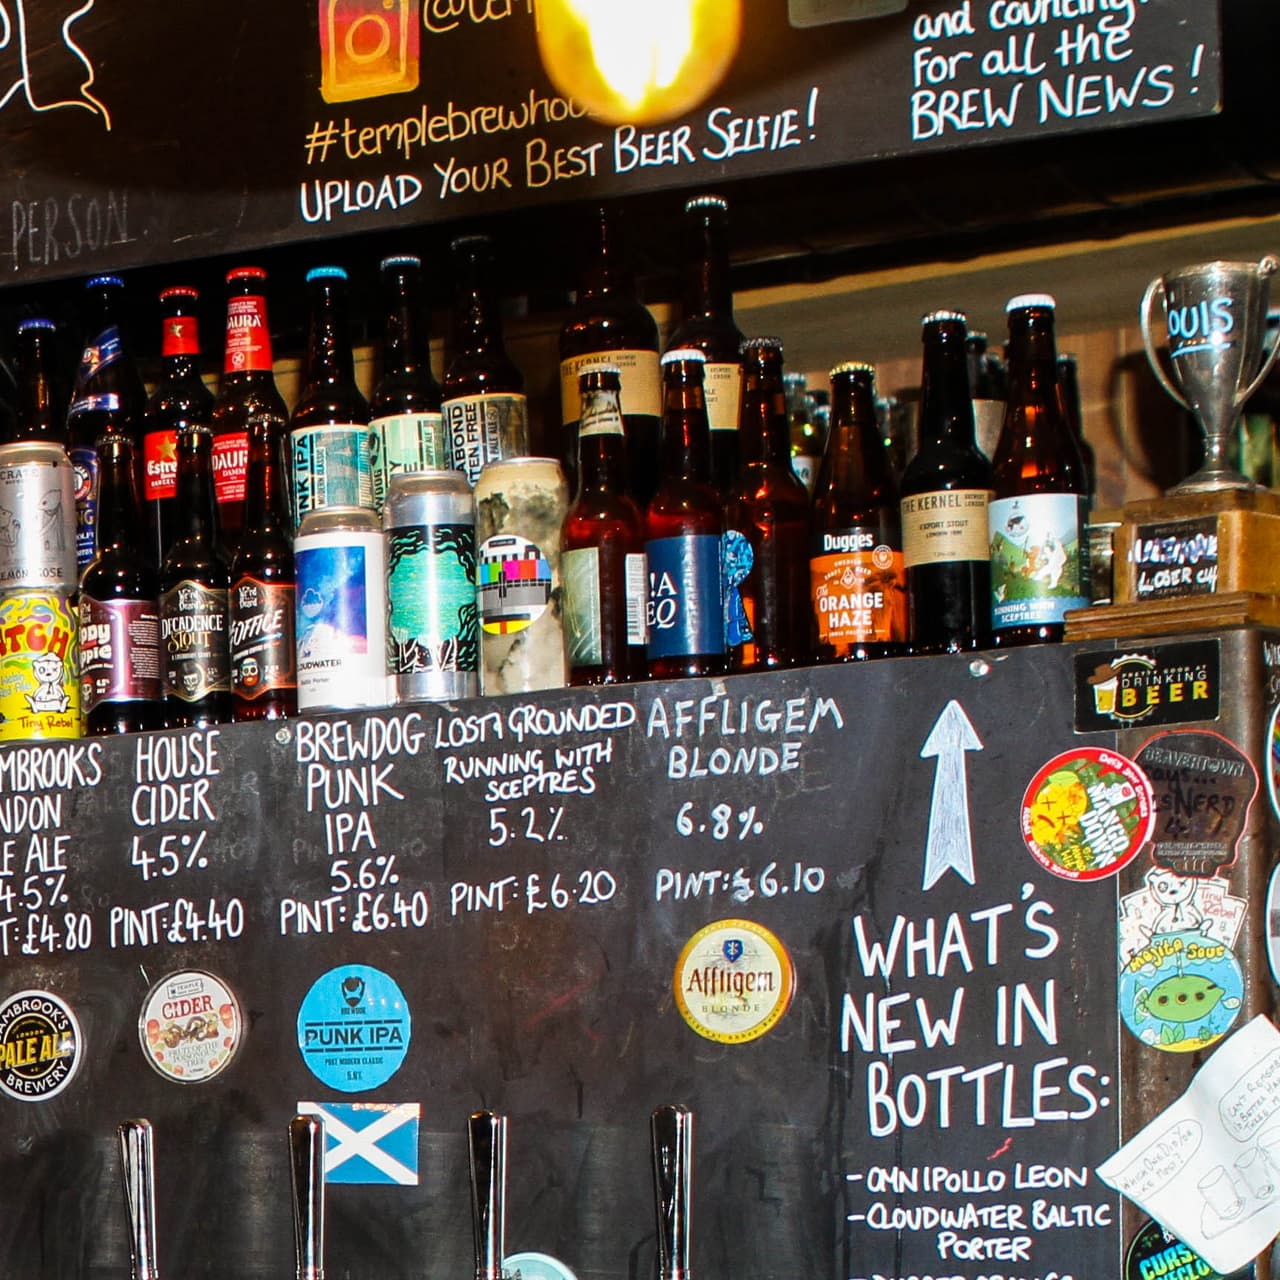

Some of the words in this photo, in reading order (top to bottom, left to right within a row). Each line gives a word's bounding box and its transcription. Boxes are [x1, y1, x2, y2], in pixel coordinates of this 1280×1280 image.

[913, 9, 973, 42] and
[981, 32, 1047, 75] all
[1055, 16, 1134, 66] the
[911, 82, 1024, 140] BREW
[300, 174, 423, 222] UPLOAD
[433, 157, 512, 199] YOUR
[526, 138, 604, 188] BEST
[614, 124, 696, 173] BEER
[918, 495, 961, 512] KERNEL
[823, 530, 873, 552] Dugges
[819, 592, 884, 612] ORANGE
[829, 609, 872, 629] HAZE
[161, 615, 223, 639] DECADENCE
[1122, 670, 1207, 688] DRINKING
[1122, 680, 1209, 707] BEER
[294, 712, 426, 763] BREWDOG
[508, 701, 637, 743] GROUNDED
[646, 696, 844, 740] AFFLIGEM
[136, 729, 221, 784] HOUSE
[444, 750, 542, 785] RUNNING
[554, 742, 612, 767] WITH
[668, 741, 803, 779] BLONDE
[131, 778, 216, 826] CIDER
[307, 763, 405, 812] PUNK
[485, 765, 596, 802] SCEPTRES
[325, 811, 377, 855] IPA
[676, 801, 764, 841] 6.8%
[24, 833, 71, 873] ALE
[853, 882, 1060, 981] WHAT'S
[686, 967, 774, 995] Affligem
[162, 995, 212, 1020] CIDER
[841, 987, 964, 1053] NEW
[997, 979, 1058, 1047] IN
[304, 1027, 361, 1047] PUNK
[370, 1026, 403, 1045] IPA
[868, 1057, 1110, 1137] BOTTLES:
[1014, 1162, 1088, 1189] LEON
[866, 1202, 1028, 1231] CLOUDWATER
[1032, 1199, 1112, 1231] BALTIC
[937, 1230, 1032, 1262] PORTER
